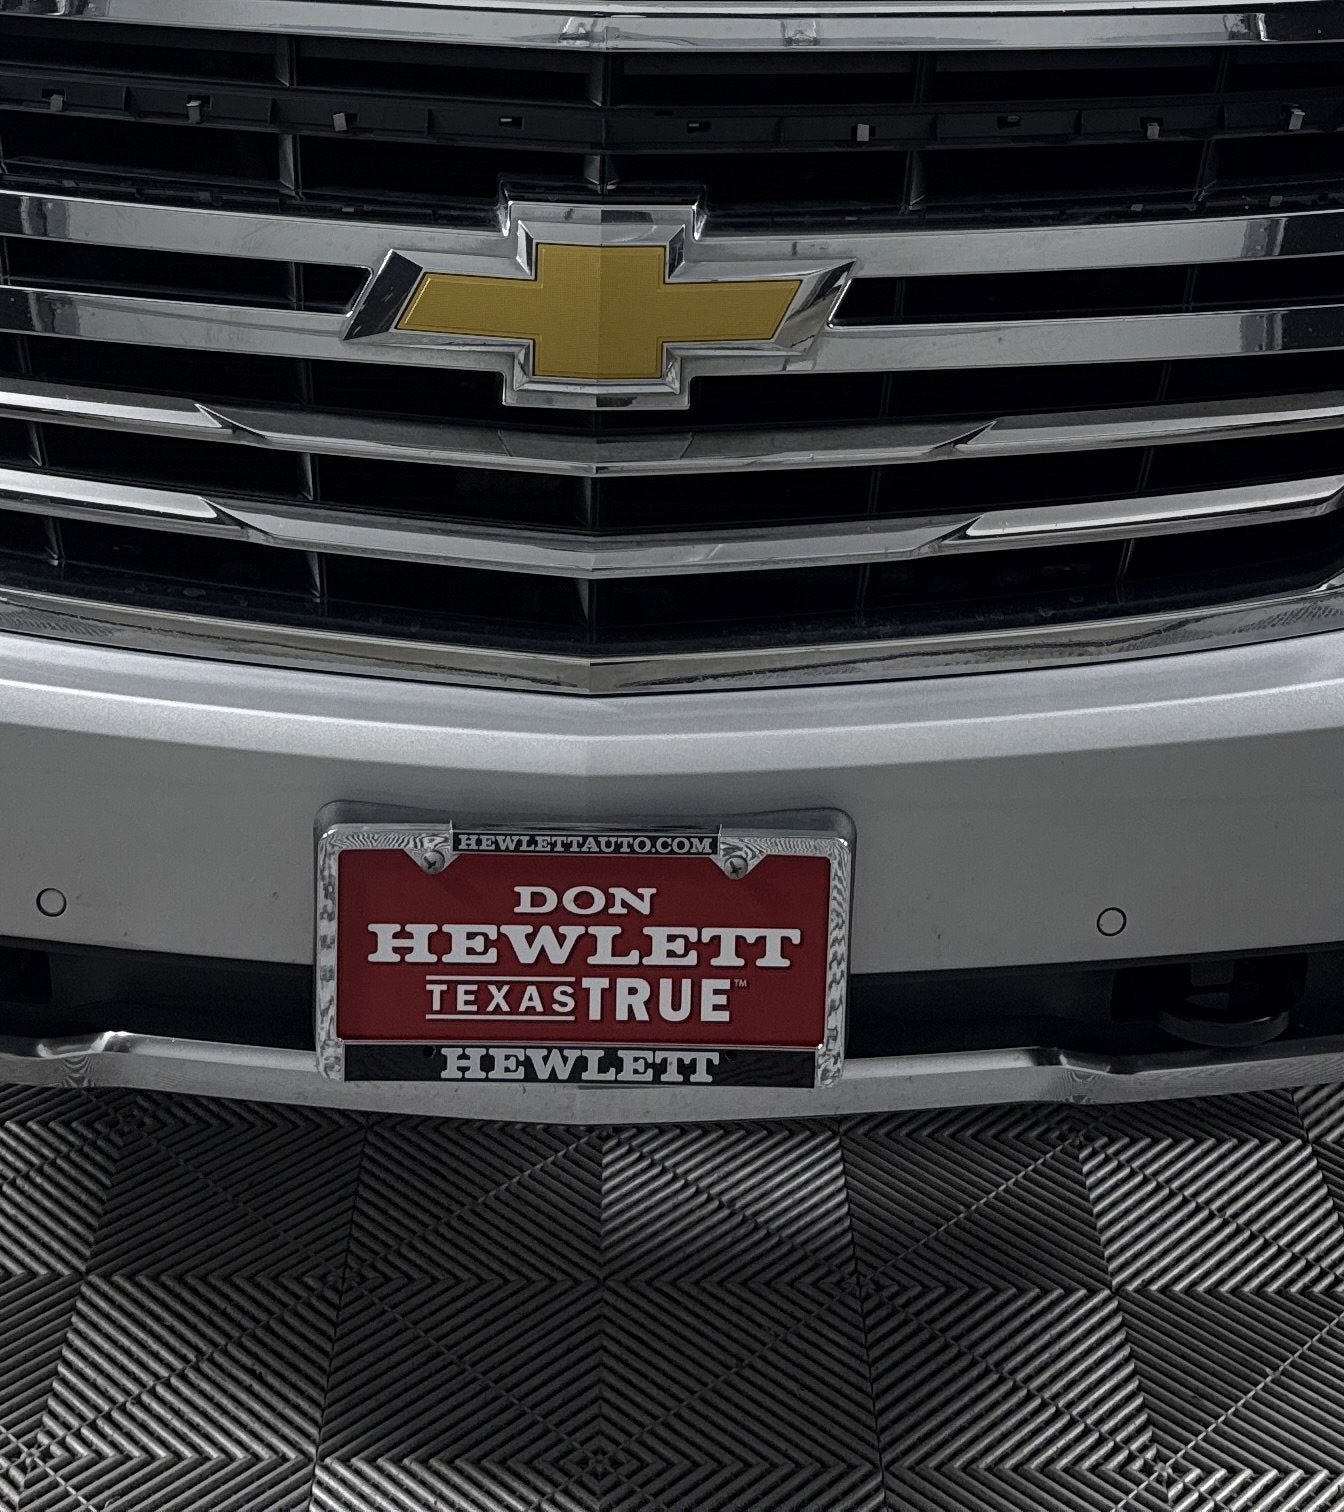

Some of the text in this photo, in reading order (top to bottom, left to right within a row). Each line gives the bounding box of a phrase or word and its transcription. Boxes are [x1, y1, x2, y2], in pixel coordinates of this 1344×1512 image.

[458, 834, 713, 855] HEWLETTAUTO.COM
[513, 885, 657, 916] DON
[367, 923, 801, 968] HEWLETT
[440, 1046, 720, 1083] HEWLETT
